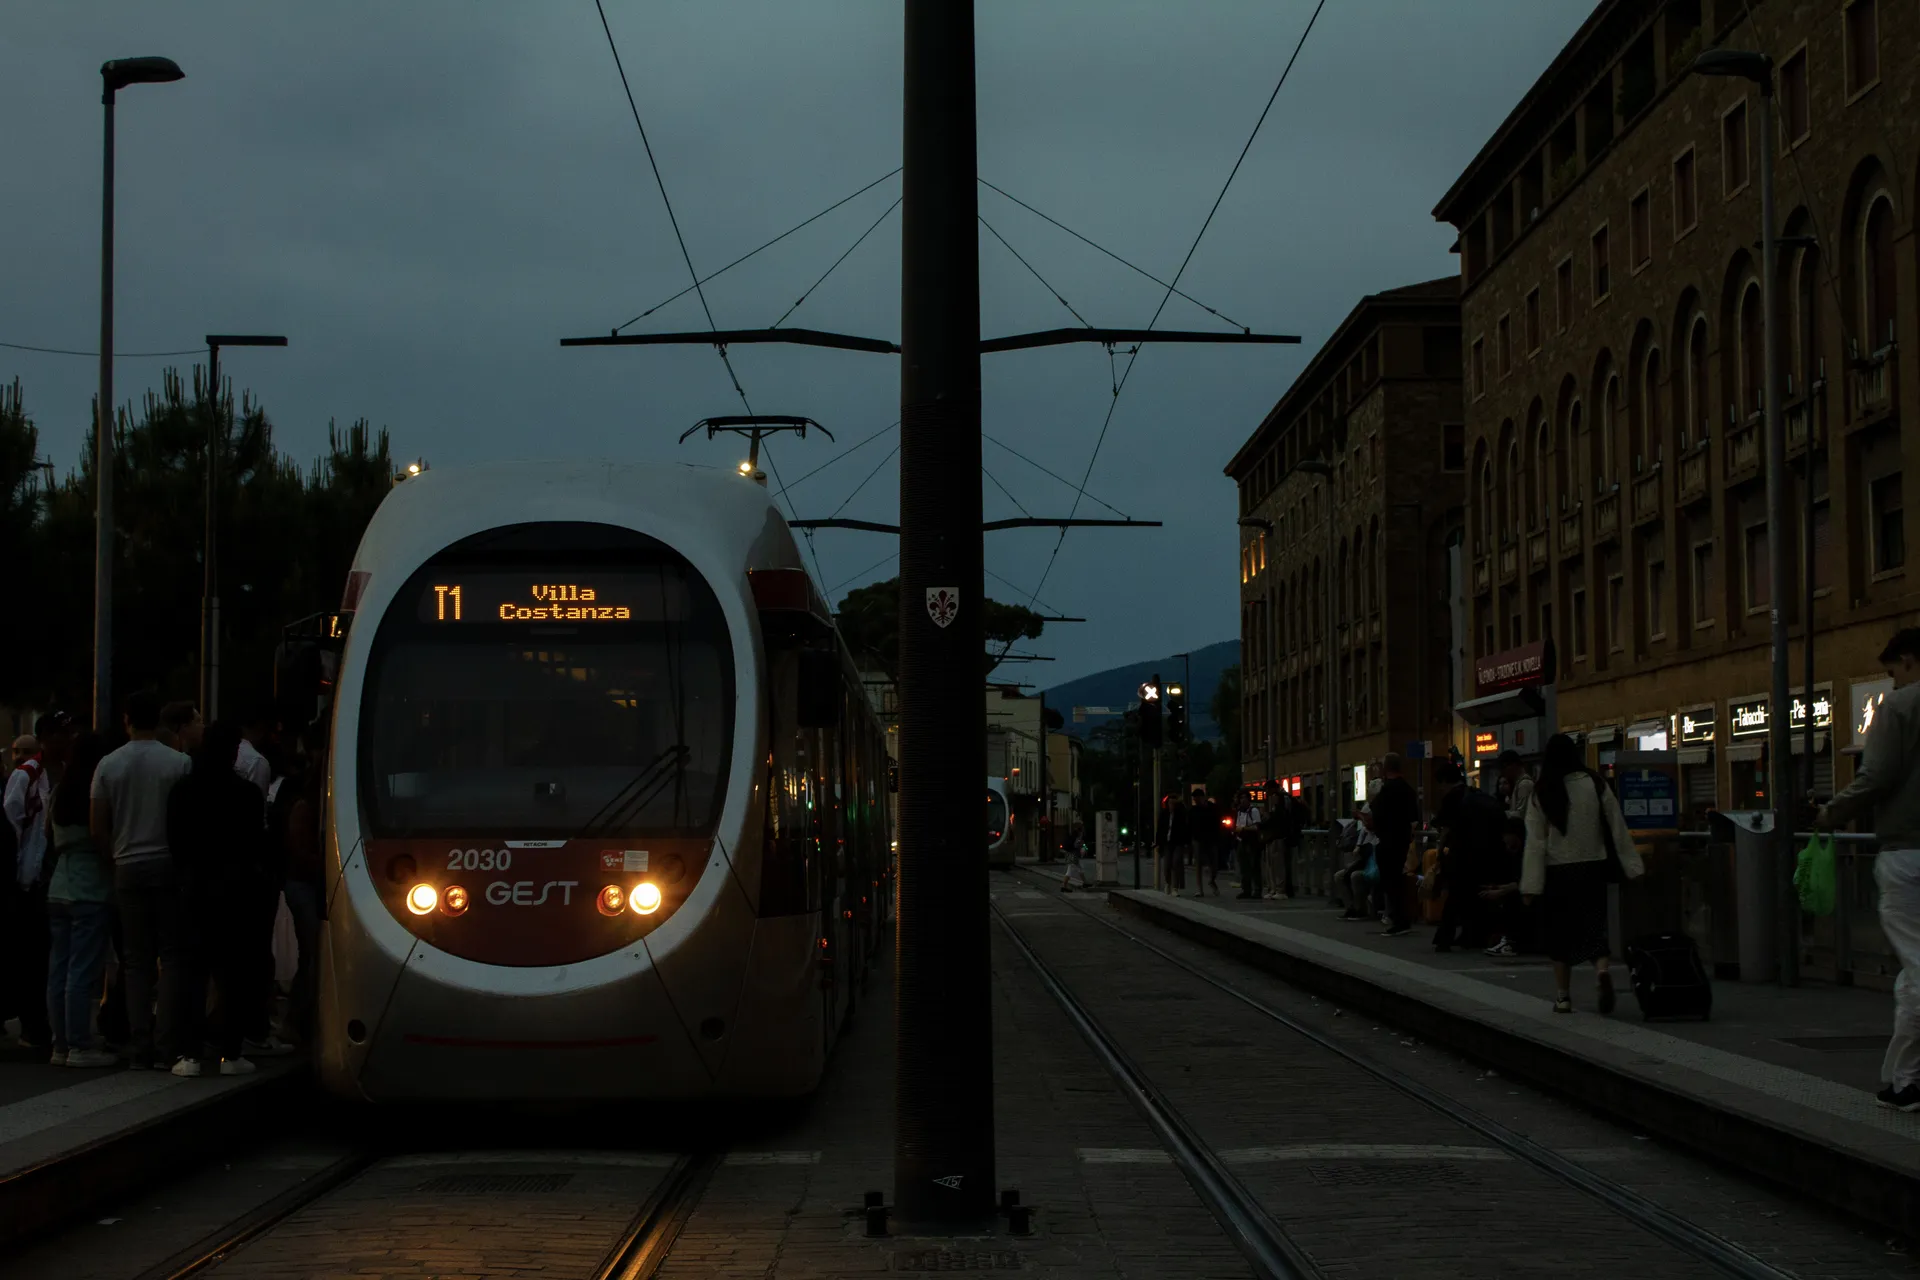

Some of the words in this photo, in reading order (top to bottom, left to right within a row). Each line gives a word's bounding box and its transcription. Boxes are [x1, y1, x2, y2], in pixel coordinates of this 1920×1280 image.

[435, 585, 461, 620] T1
[532, 585, 595, 601] Villa
[500, 603, 630, 620] Costanza
[1683, 715, 1695, 734] Bar
[1737, 704, 1765, 727] Tabacchi
[447, 849, 512, 871] 2030
[485, 881, 579, 906] GEST
